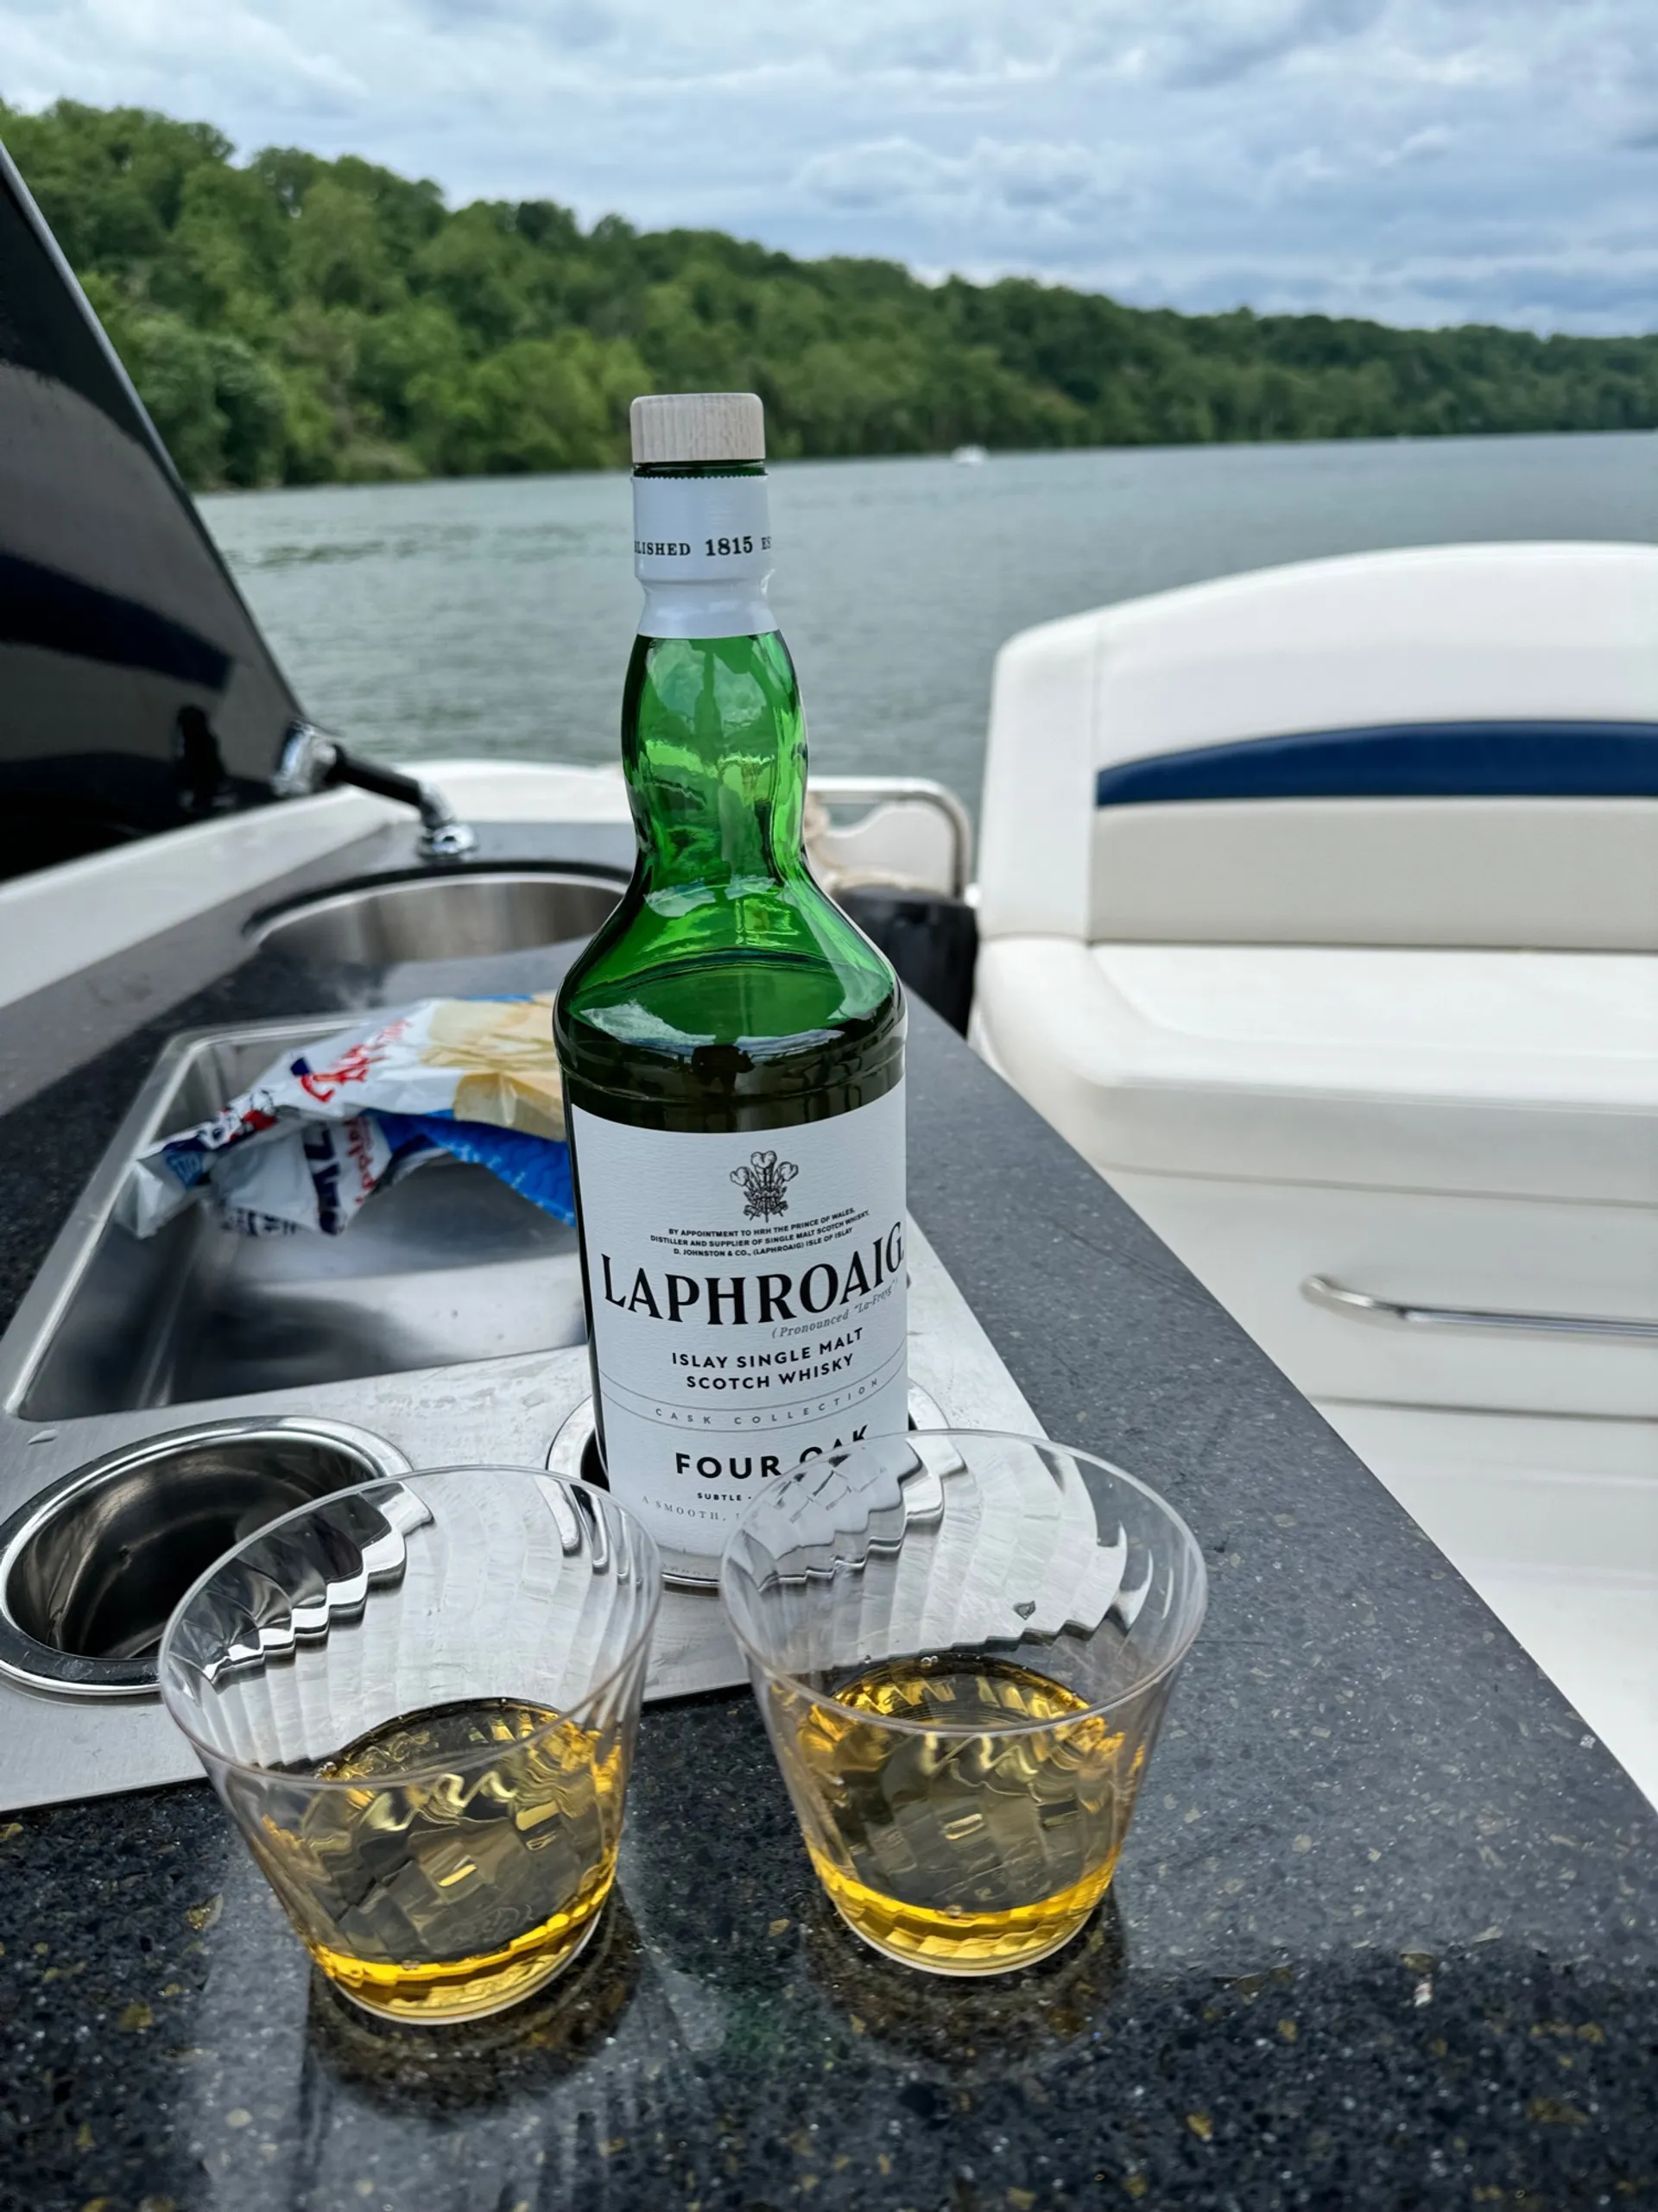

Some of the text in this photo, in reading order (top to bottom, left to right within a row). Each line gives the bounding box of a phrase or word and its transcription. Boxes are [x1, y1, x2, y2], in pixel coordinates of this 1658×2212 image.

[706, 535, 753, 557] 1815
[650, 1235, 688, 1246] DISTILLER
[709, 1239, 750, 1248] SUPPLIER
[764, 1234, 794, 1244] SINGLE
[796, 1229, 815, 1239] MALT
[817, 1221, 844, 1235] SCOTCH
[791, 1218, 819, 1230] PRINCE
[820, 1215, 831, 1223] OF
[753, 1242, 804, 1255] (LAPHROAIG)
[806, 1237, 822, 1247] ISLE
[824, 1234, 833, 1242] OF
[834, 1227, 853, 1239] ISLAY
[601, 1222, 905, 1325] LAPHROAIG
[672, 1327, 864, 1369] ISLAY SINGLE MALT
[687, 1352, 854, 1390] SCOTCH WHISKY
[655, 1378, 879, 1425] CASK COLLECTION
[675, 1451, 782, 1480] FOUR
[697, 1492, 742, 1501] SUBTLE
